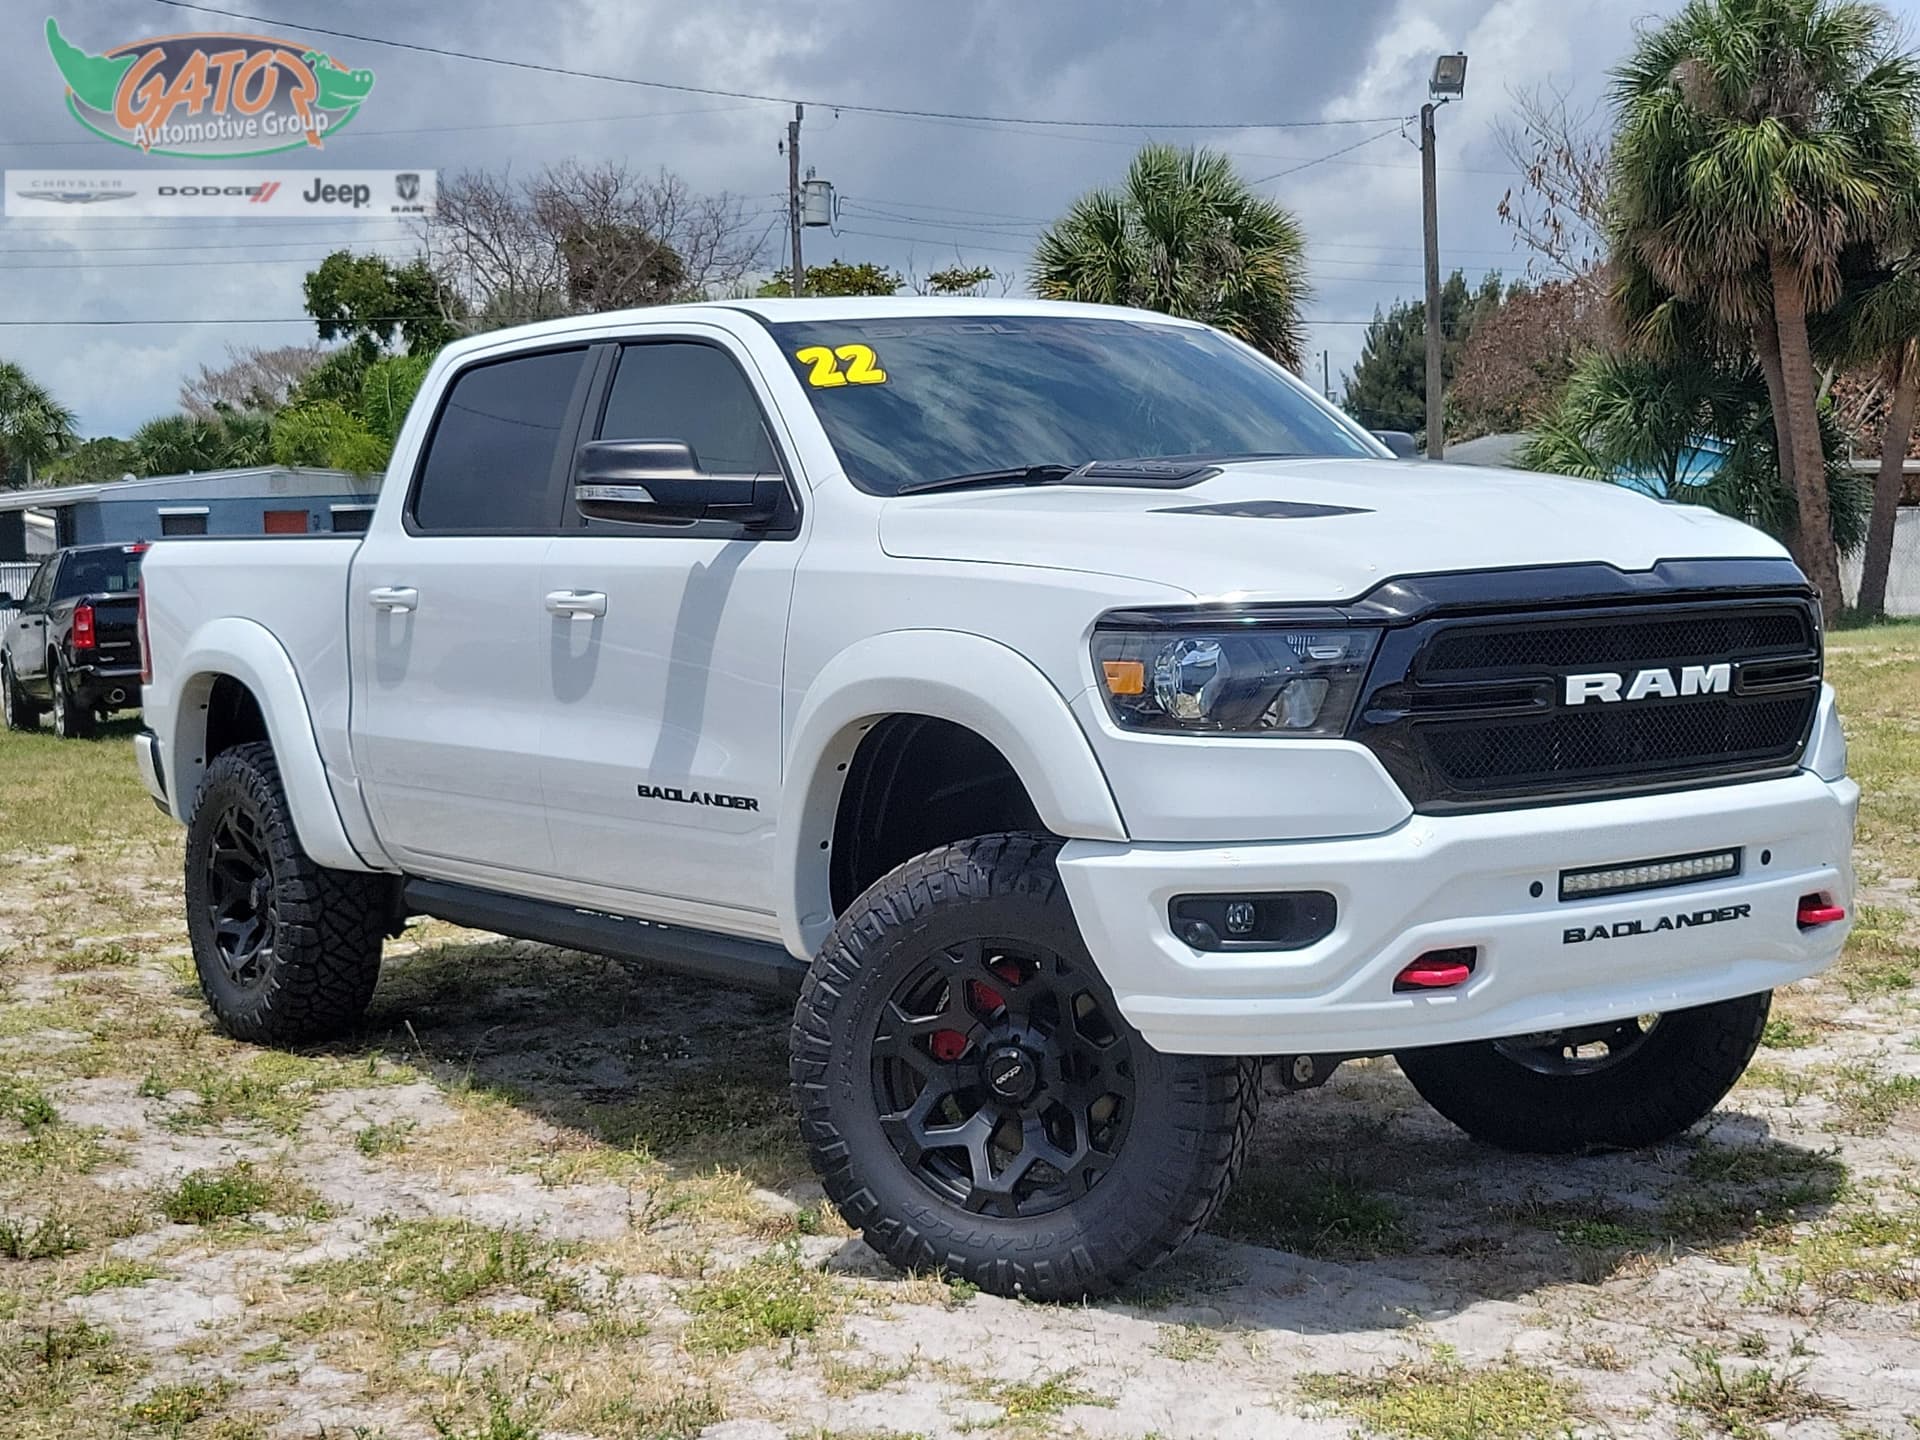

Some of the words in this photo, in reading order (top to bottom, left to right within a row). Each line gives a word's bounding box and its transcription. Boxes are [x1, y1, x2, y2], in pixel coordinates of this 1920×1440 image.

[796, 344, 887, 388] 22
[1565, 663, 1731, 705] RAM
[637, 784, 760, 812] BADLANDER
[1562, 903, 1752, 944] BADLANDER
